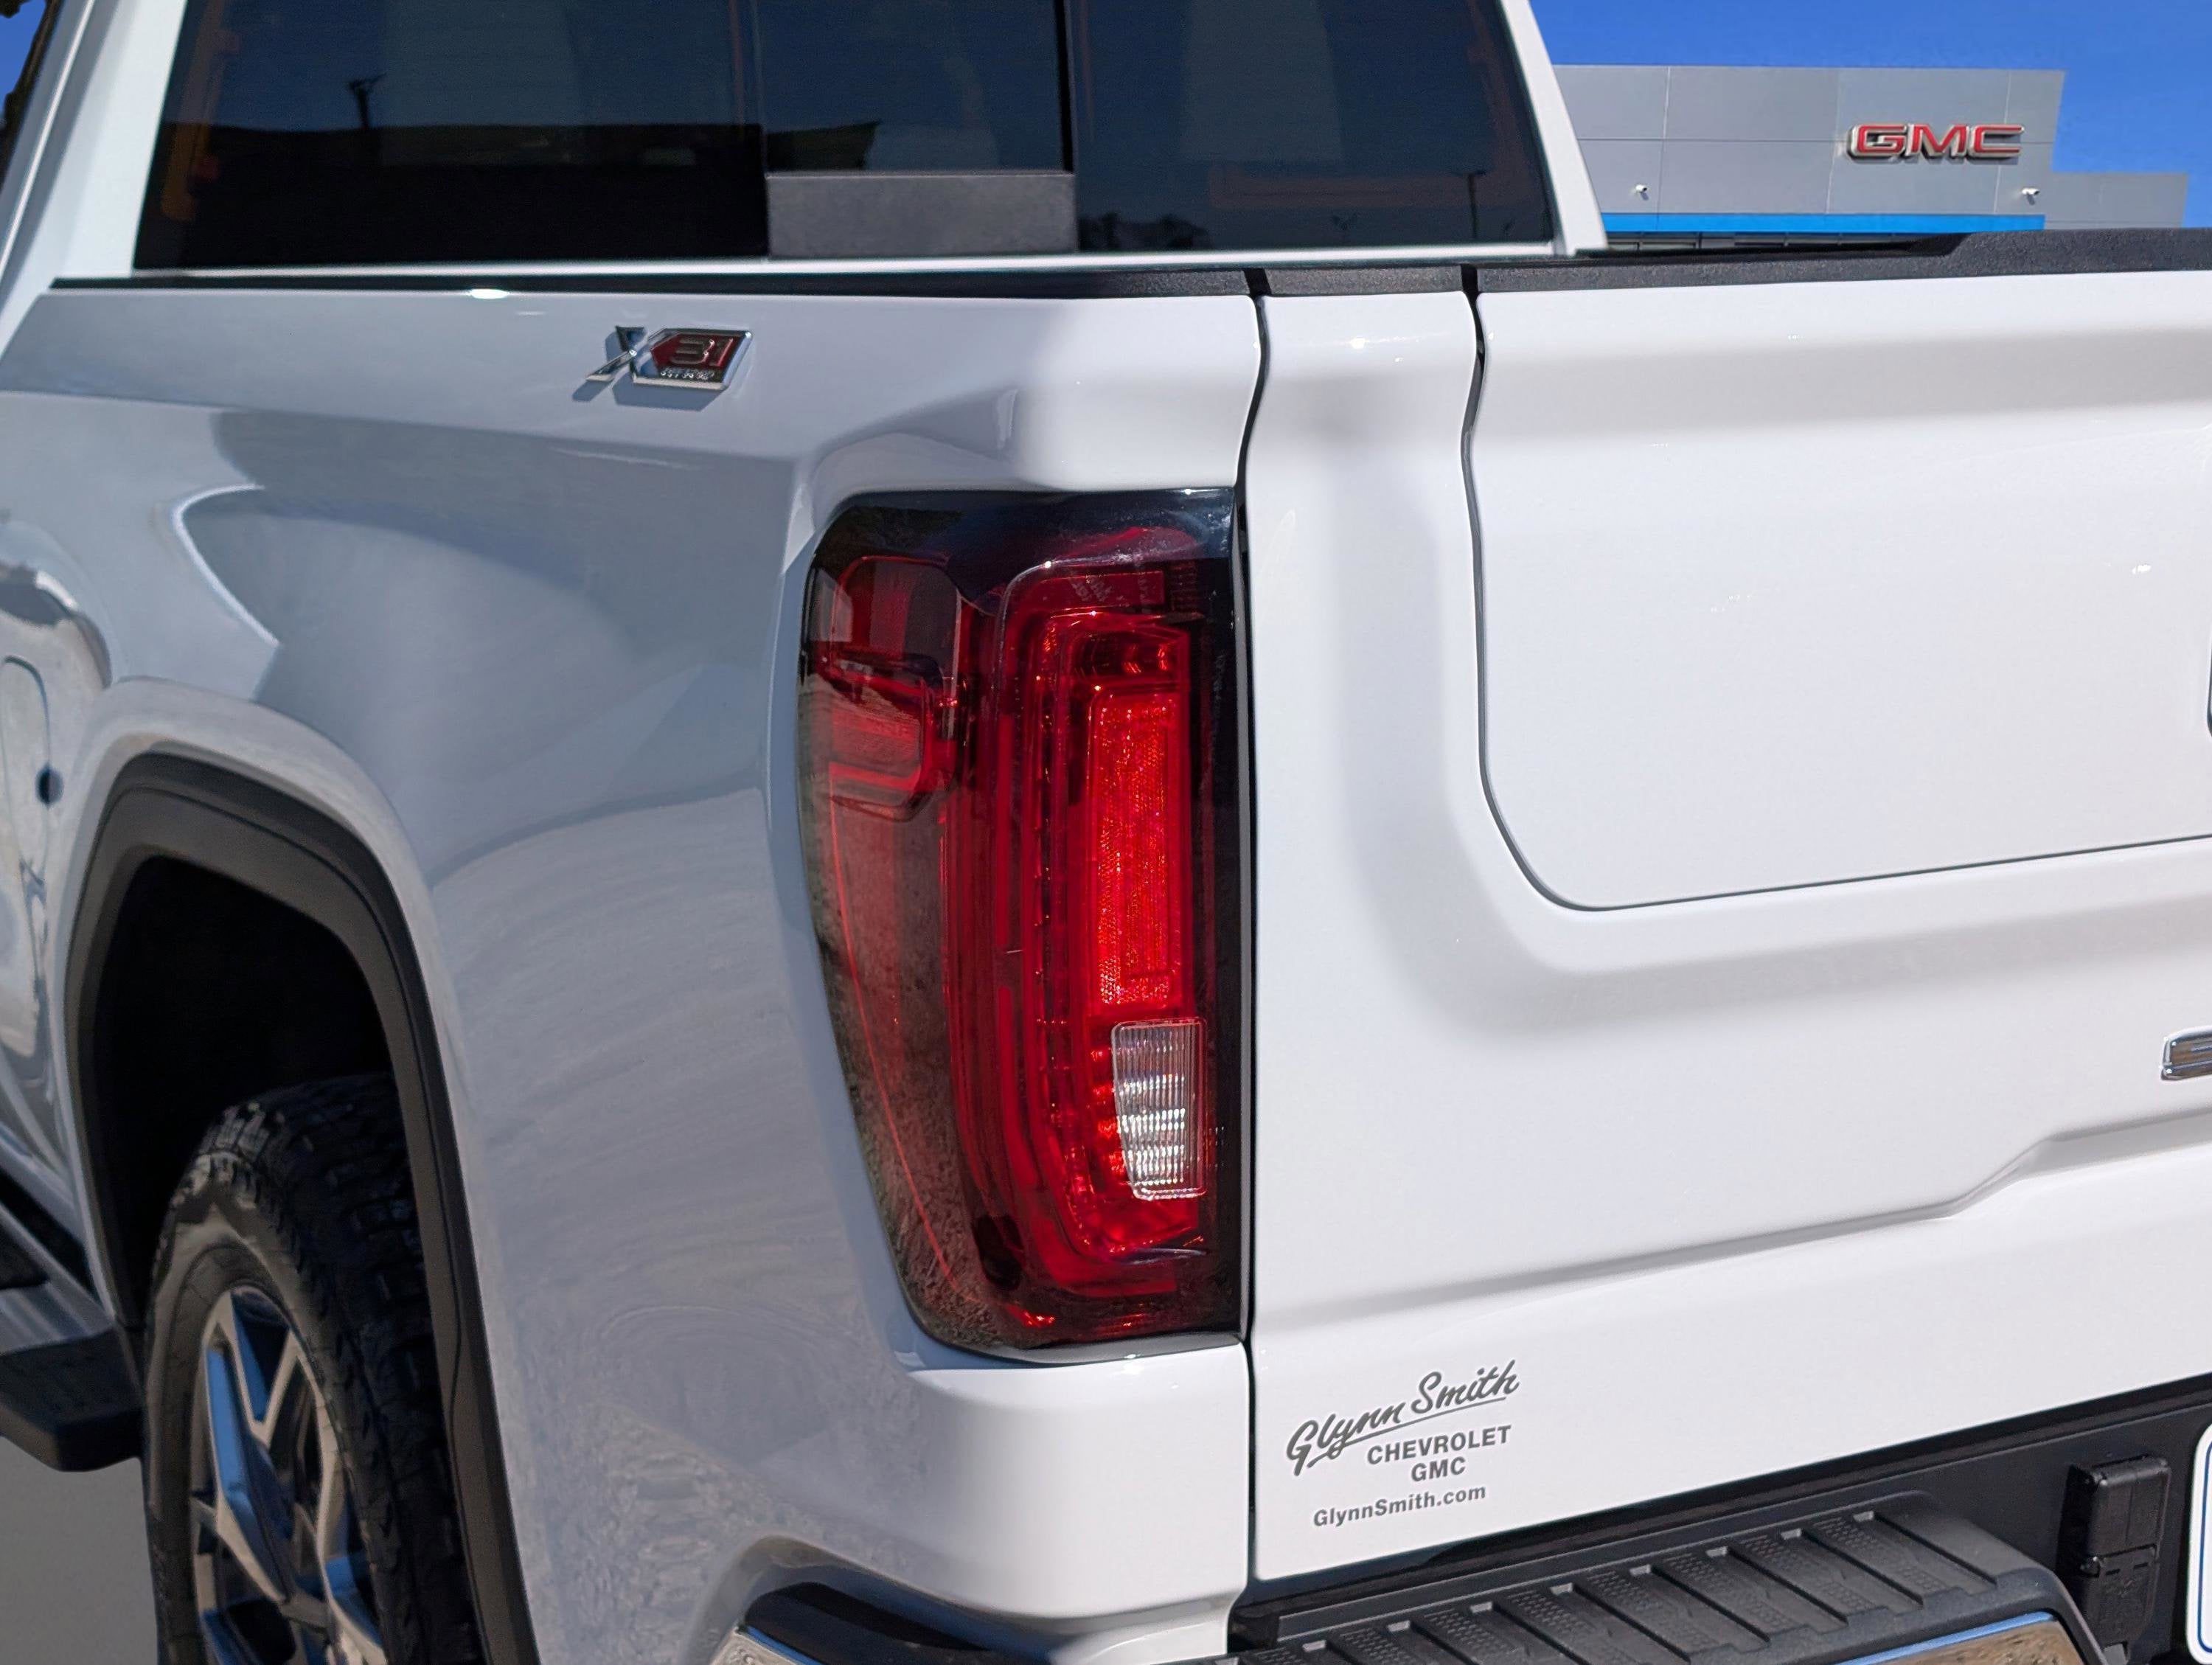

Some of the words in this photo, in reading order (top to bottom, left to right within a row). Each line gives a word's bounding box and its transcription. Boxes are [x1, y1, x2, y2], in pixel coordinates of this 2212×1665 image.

[1848, 123, 2024, 159] GMC
[1286, 1402, 1406, 1476] Glynn
[1411, 1359, 1520, 1414] Smith
[1367, 1425, 1512, 1465] CHEVROLET
[1411, 1456, 1466, 1482] GMC
[1313, 1487, 1486, 1527] GlynnSmith.com
